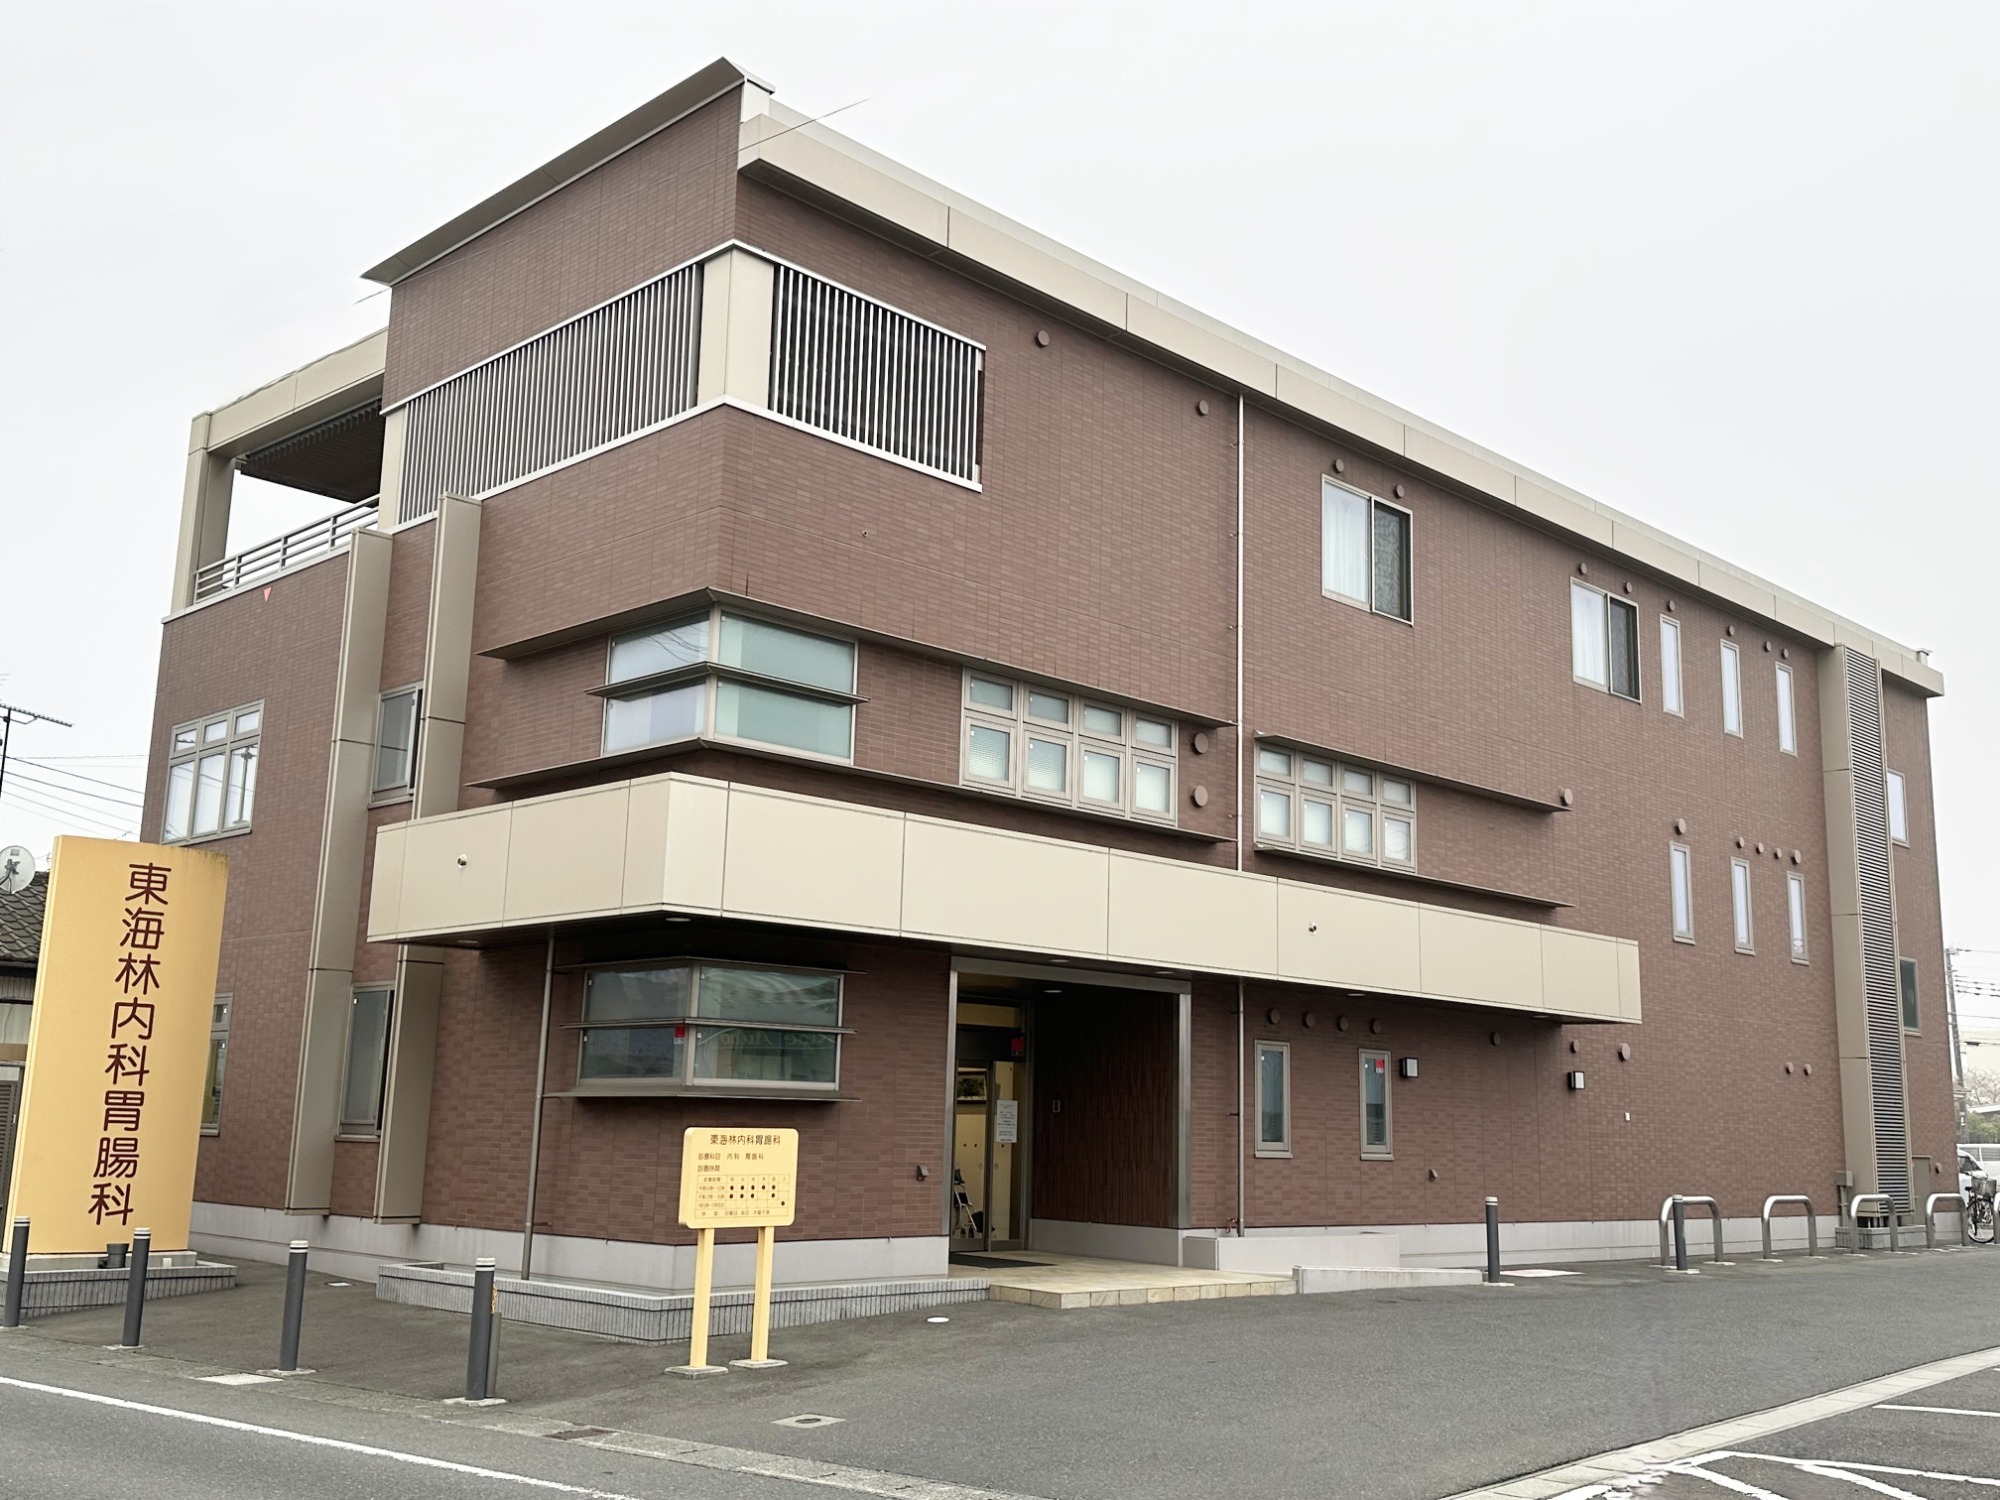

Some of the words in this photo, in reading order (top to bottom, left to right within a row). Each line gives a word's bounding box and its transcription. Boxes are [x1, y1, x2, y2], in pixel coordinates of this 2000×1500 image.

[88, 862, 172, 1226] 東海林内科胃腸科
[710, 1134, 781, 1145] 東海林内科胃腸科
